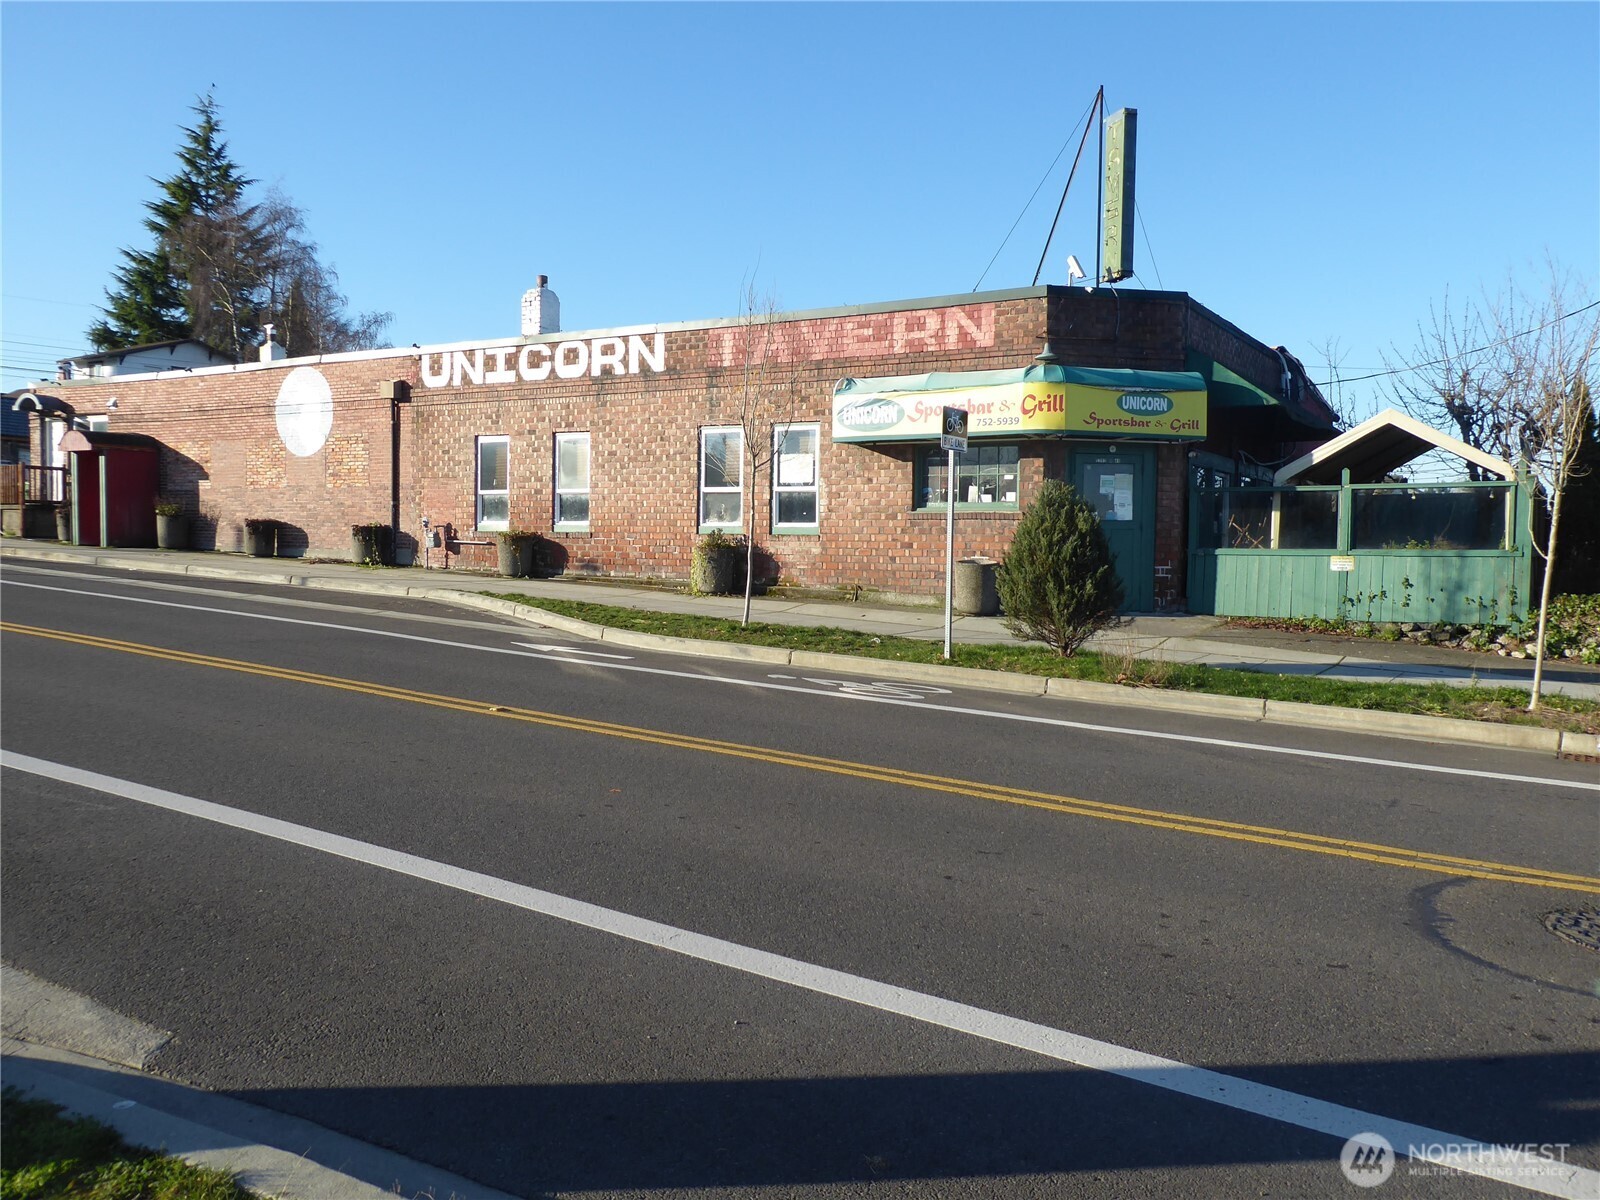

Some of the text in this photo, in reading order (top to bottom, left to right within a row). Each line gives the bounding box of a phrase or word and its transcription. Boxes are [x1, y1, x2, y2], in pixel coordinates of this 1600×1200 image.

[708, 303, 996, 367] TAVERN
[421, 333, 666, 388] UNICORN
[907, 393, 1065, 422] Spobar & Grill
[1122, 395, 1168, 411] UNICORN
[843, 404, 898, 426] UNICORN
[976, 416, 1020, 427] 752-5939
[1083, 411, 1200, 432] Sportsbar & Grill
[943, 436, 966, 449] BIKE LANE
